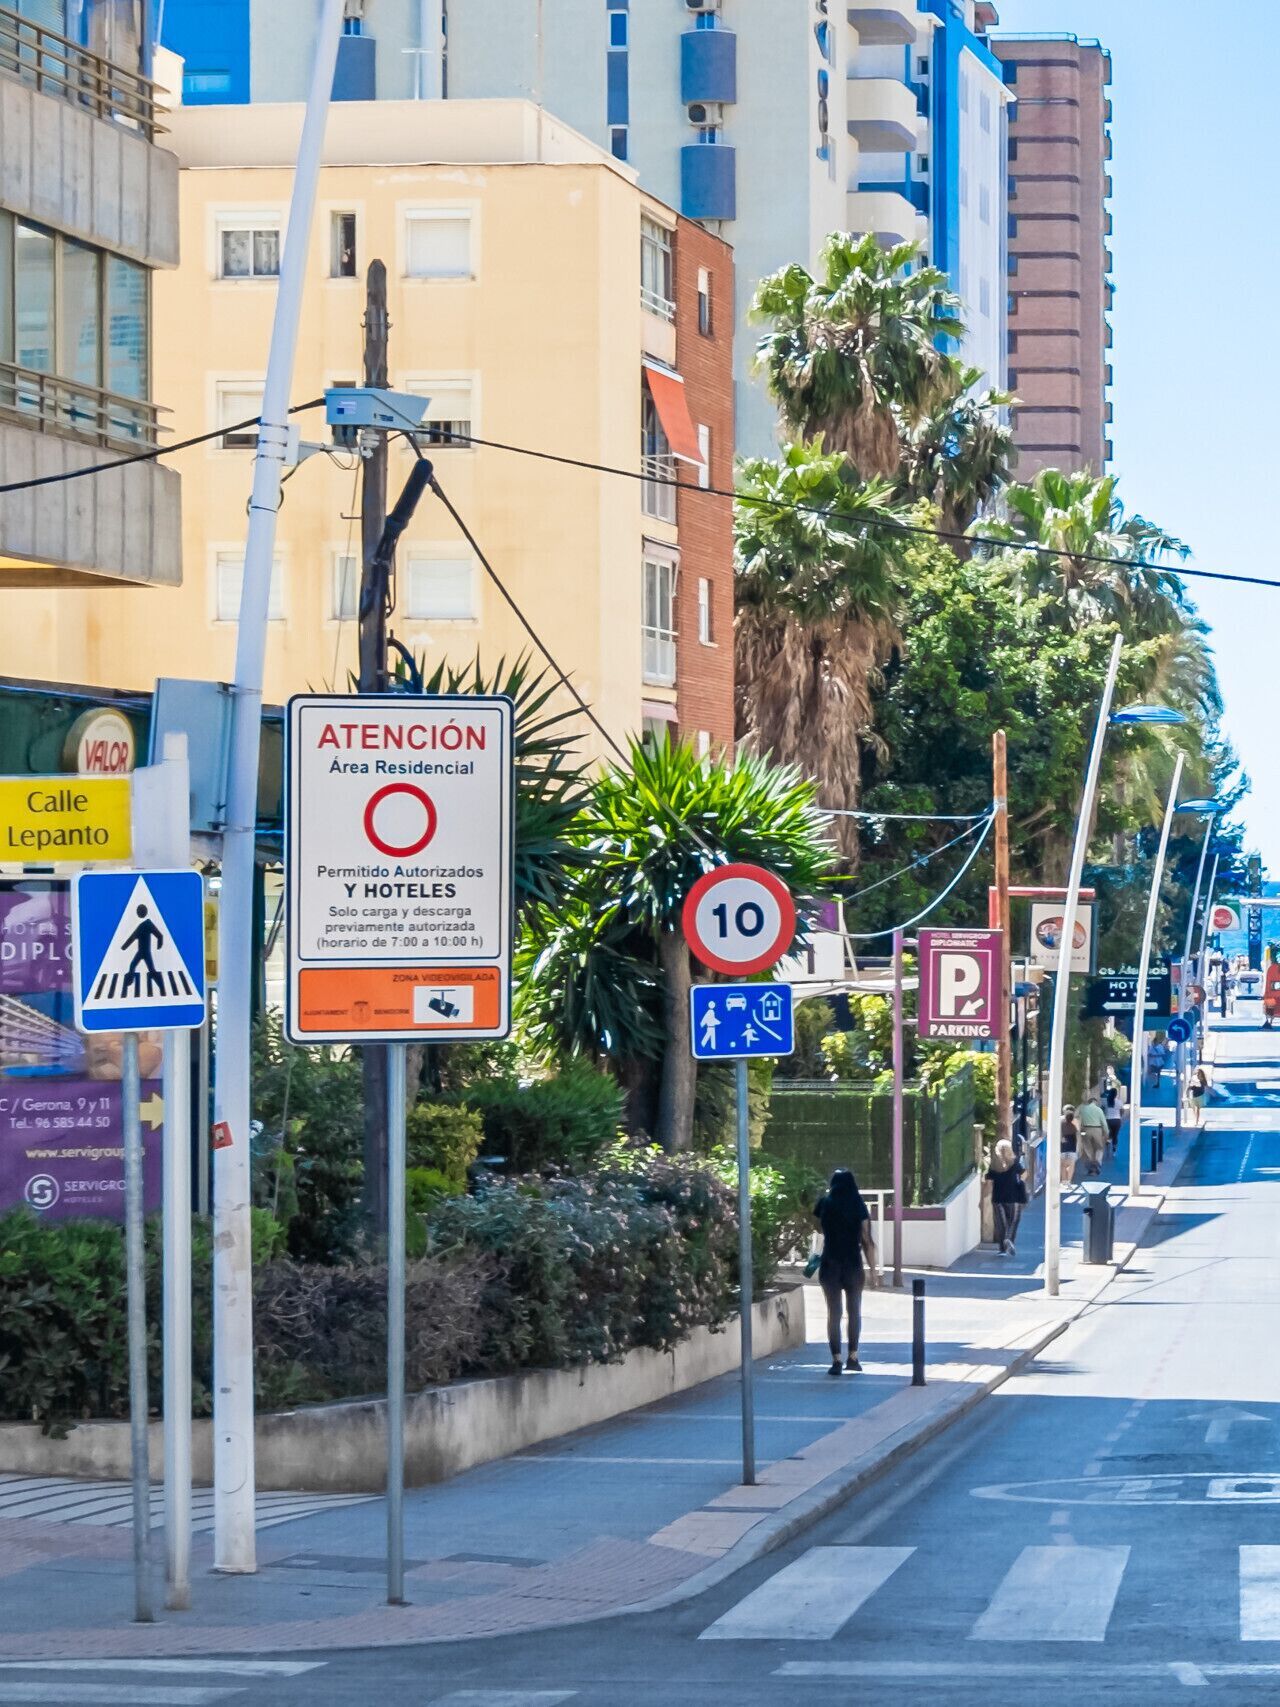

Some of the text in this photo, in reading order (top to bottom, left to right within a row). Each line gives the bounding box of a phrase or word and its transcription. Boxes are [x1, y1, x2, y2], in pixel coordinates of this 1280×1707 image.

[317, 718, 486, 750] ATENCIÓN
[86, 739, 128, 771] VALOR
[329, 756, 474, 774] Área Residencial
[28, 790, 88, 812] Calle
[8, 826, 109, 850] Lepanto
[317, 865, 484, 878] Permitido Autorizados
[344, 883, 456, 898] Y HOTELES
[329, 906, 472, 919] Solo carga y descarga
[712, 902, 764, 938] 10
[325, 921, 476, 934] previamente autorizada
[316, 936, 484, 950] (horario de 7:00 a 10:00 h)
[930, 939, 978, 947] DIPLOMATIC
[392, 973, 496, 982] ZONA VIDEOVIGILADA
[940, 954, 980, 1016] P
[1110, 982, 1150, 990] HOT
[930, 1024, 991, 1037] PARKING
[78, 1098, 86, 1110] 9
[88, 1101, 98, 1114] y
[100, 1098, 110, 1110] 11
[35, 1118, 50, 1128] 96
[54, 1118, 74, 1128] 585
[77, 1118, 92, 1128] 44
[96, 1116, 110, 1128] 50
